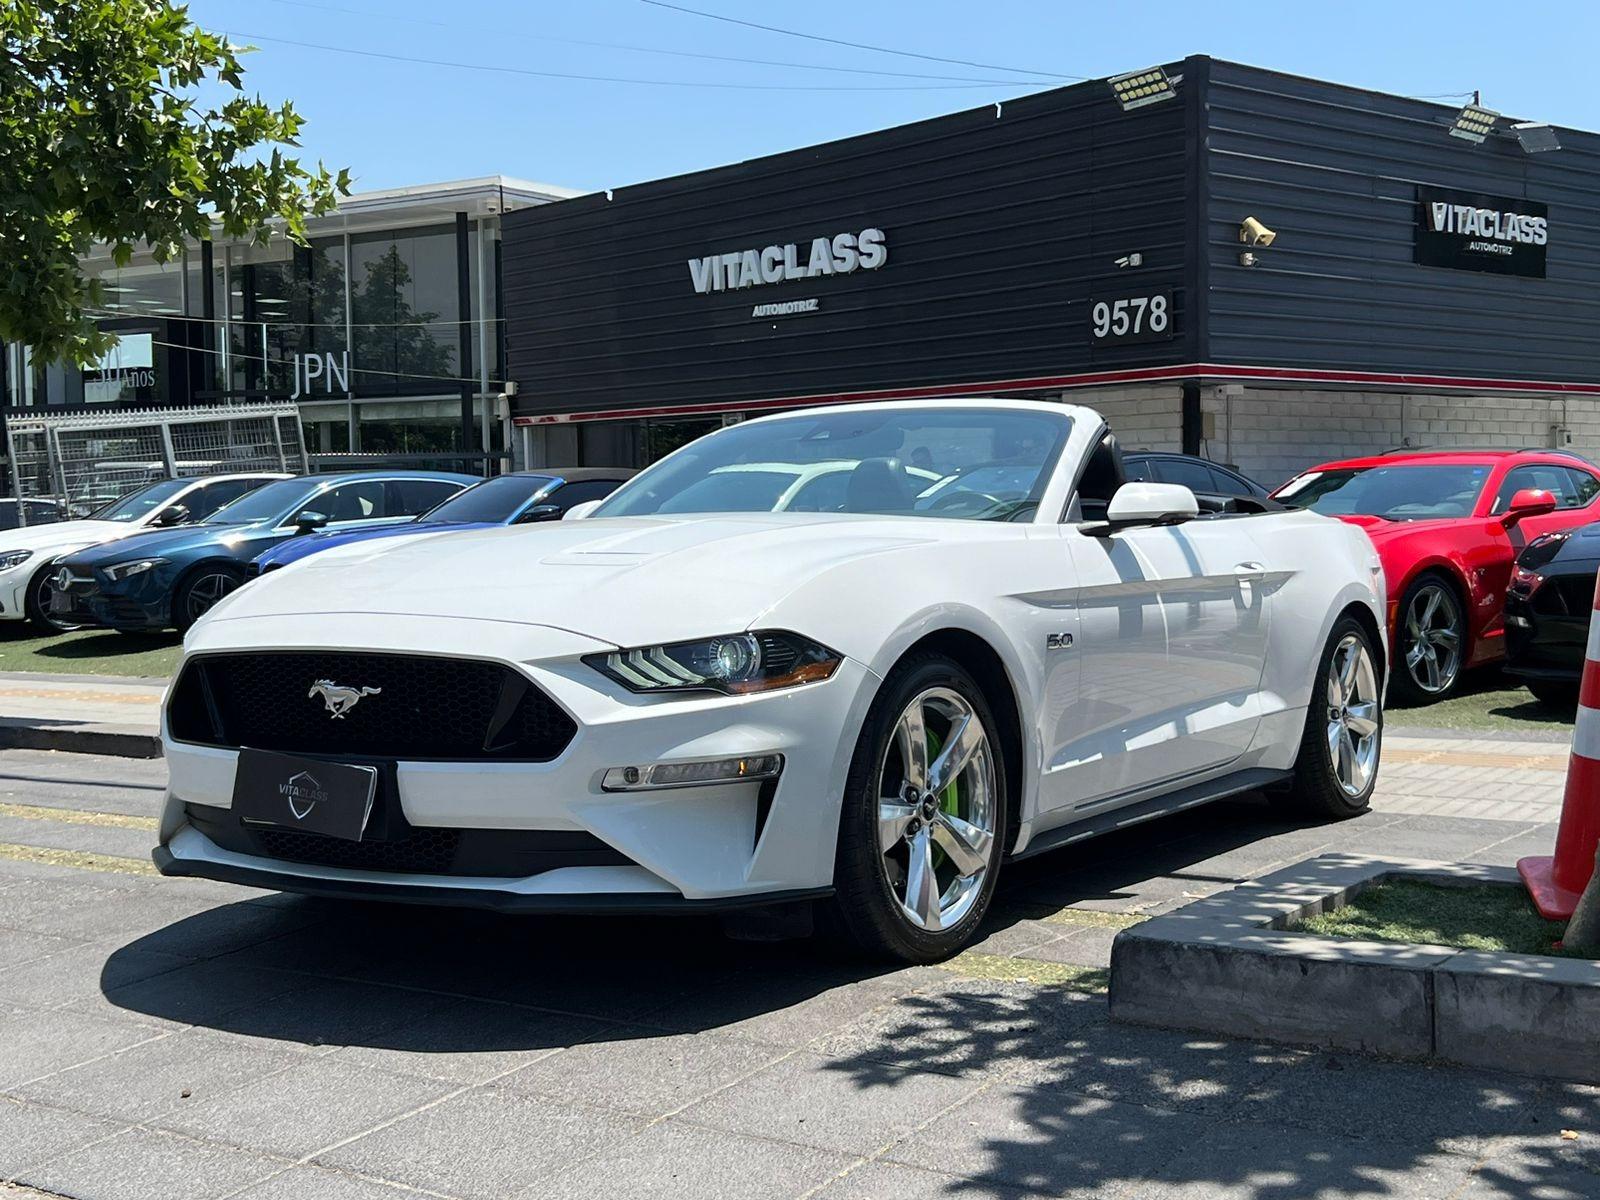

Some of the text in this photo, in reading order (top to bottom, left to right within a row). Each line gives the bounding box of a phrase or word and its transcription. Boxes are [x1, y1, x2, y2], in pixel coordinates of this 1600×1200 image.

[1432, 201, 1547, 245] VITACLASS
[688, 228, 887, 294] VITACLASS
[1470, 241, 1513, 255] AUTOMOTRIZ
[752, 299, 819, 317] AUTOMOTRIZ
[1093, 295, 1168, 337] 9578
[291, 351, 348, 399] JPN
[279, 783, 329, 801] VITACLASS
